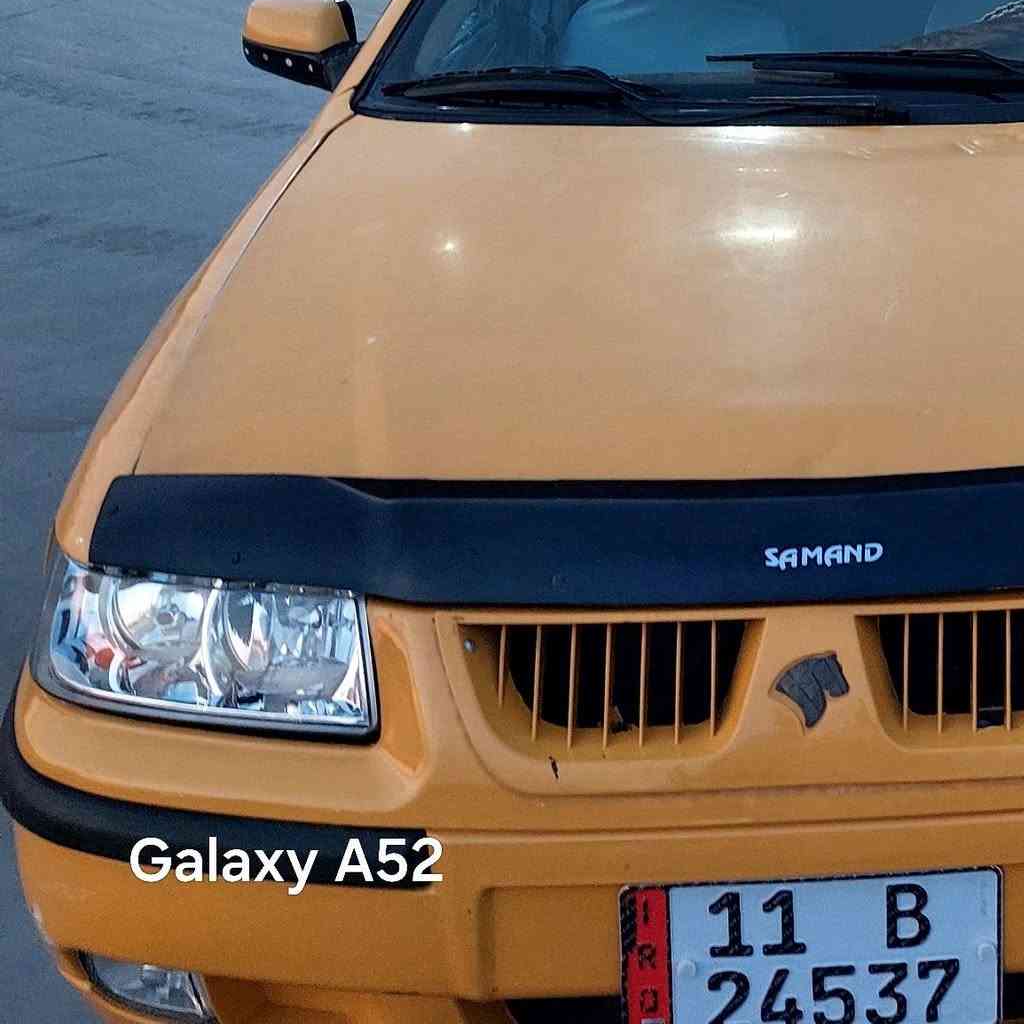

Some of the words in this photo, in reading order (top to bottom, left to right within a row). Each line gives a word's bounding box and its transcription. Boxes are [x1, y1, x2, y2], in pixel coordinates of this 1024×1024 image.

[764, 542, 884, 571] SAMAND
[708, 889, 807, 958] 11
[885, 883, 933, 950] B
[707, 957, 961, 1024] 24537
